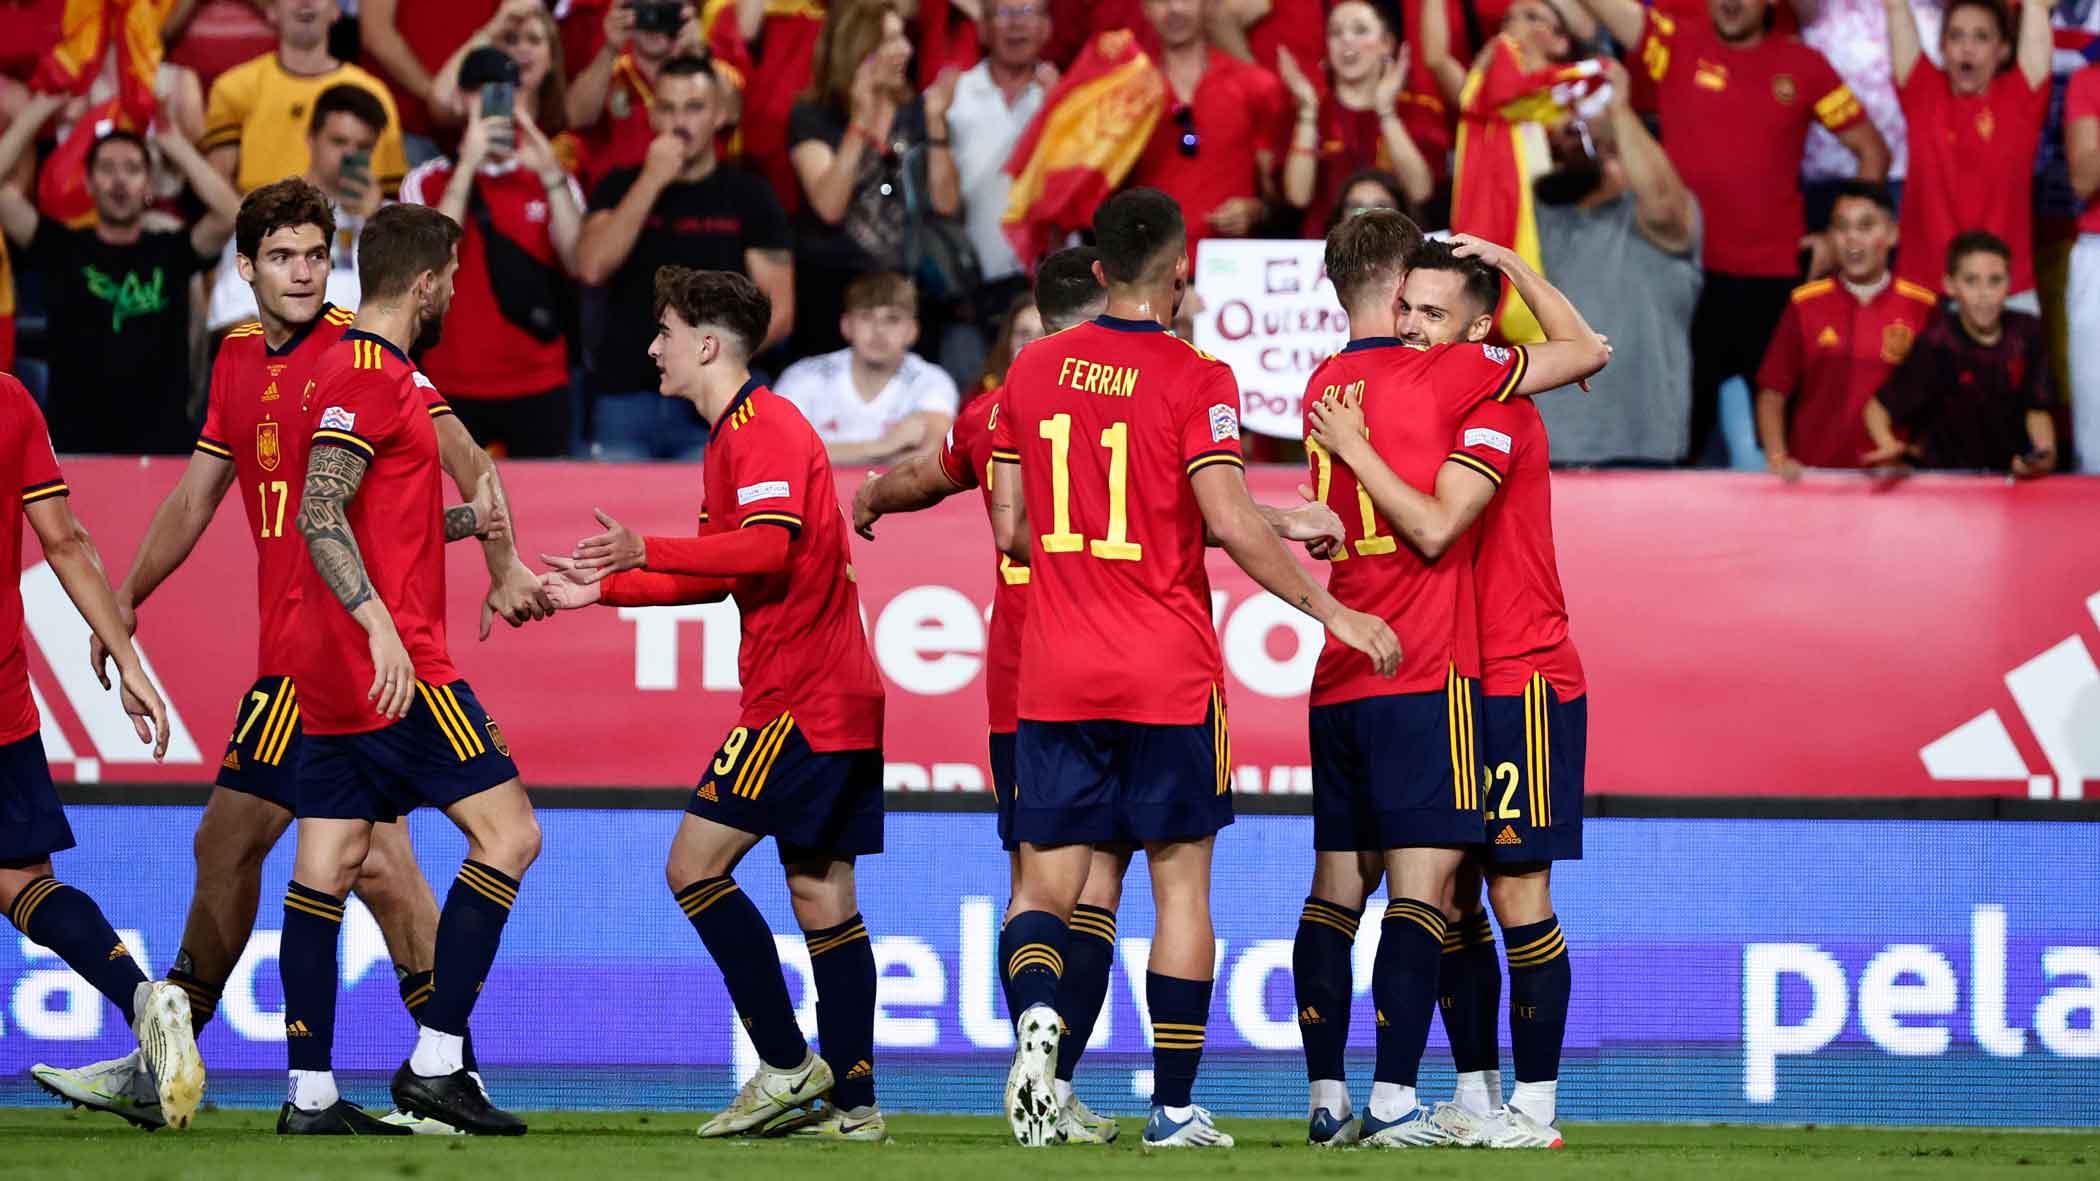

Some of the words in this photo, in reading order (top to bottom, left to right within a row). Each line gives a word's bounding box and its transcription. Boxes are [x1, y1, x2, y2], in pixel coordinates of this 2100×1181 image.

[1058, 357, 1139, 397] FERRAN
[259, 481, 288, 537] 17
[1039, 413, 1142, 561] 11
[714, 726, 748, 775] 9
